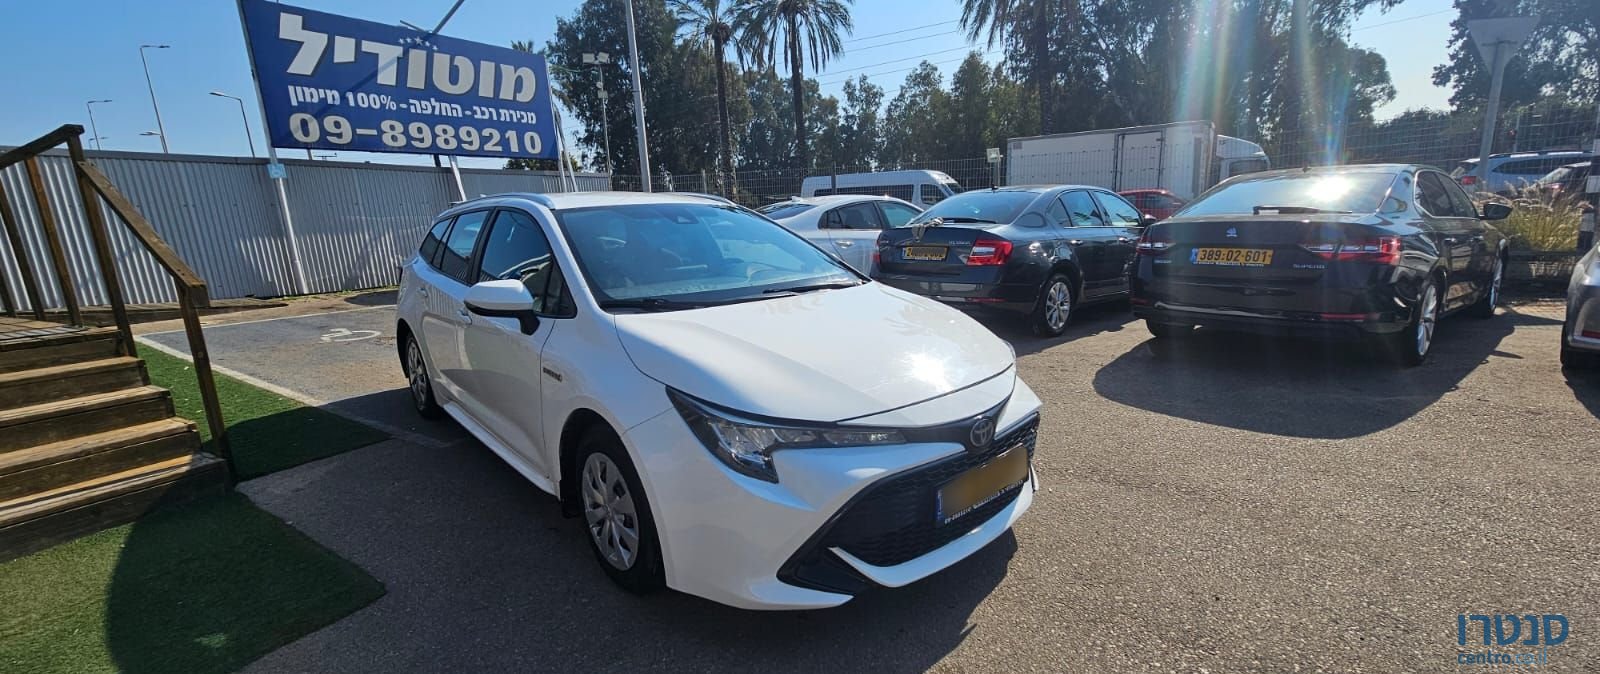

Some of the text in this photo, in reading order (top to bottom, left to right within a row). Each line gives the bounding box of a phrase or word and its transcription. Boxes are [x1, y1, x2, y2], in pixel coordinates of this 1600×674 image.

[278, 11, 537, 103] מוטודיל
[287, 85, 341, 106] מימון
[345, 91, 397, 111] 100%
[499, 108, 537, 125] מכירת
[289, 112, 542, 154] 09-8989210
